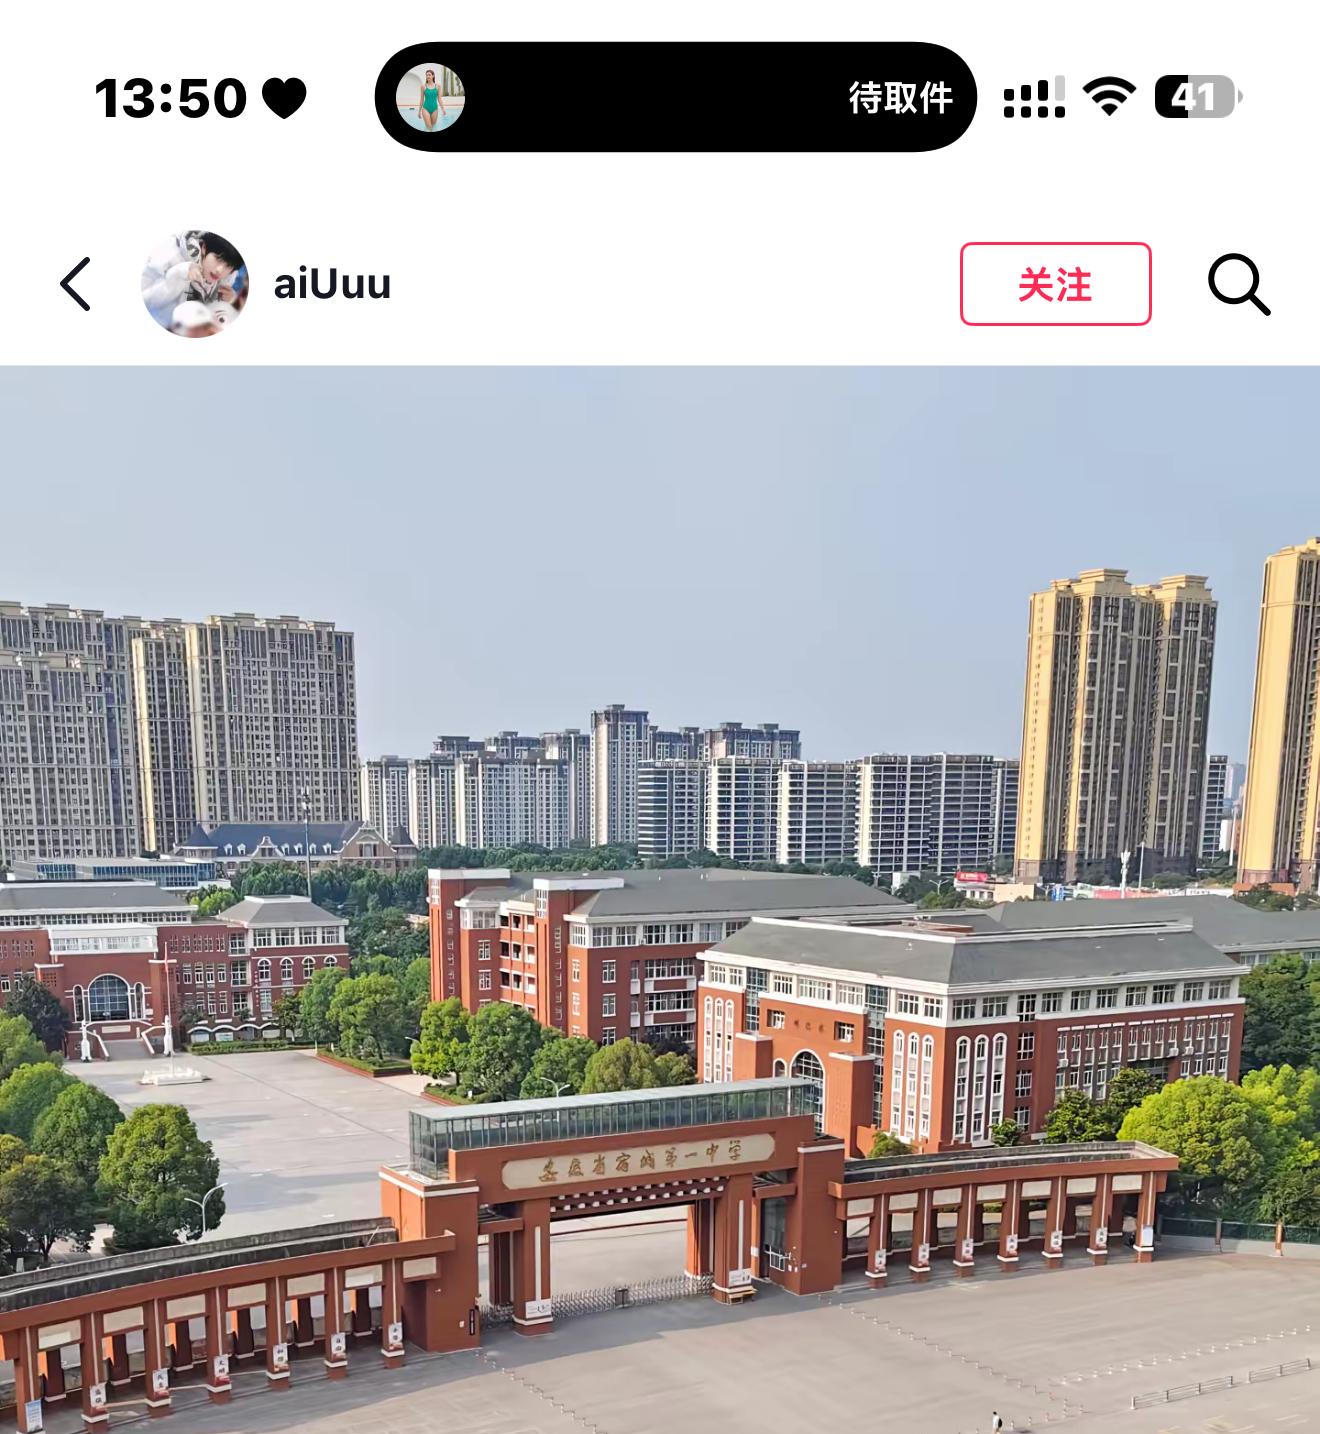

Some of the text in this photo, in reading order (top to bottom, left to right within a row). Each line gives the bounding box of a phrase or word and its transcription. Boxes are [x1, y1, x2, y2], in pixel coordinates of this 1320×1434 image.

[95, 77, 248, 119] 13:50
[848, 80, 954, 115] 待取件
[1171, 82, 1214, 111] 41
[274, 264, 391, 300] aiUuu
[1018, 265, 1093, 303] 关注
